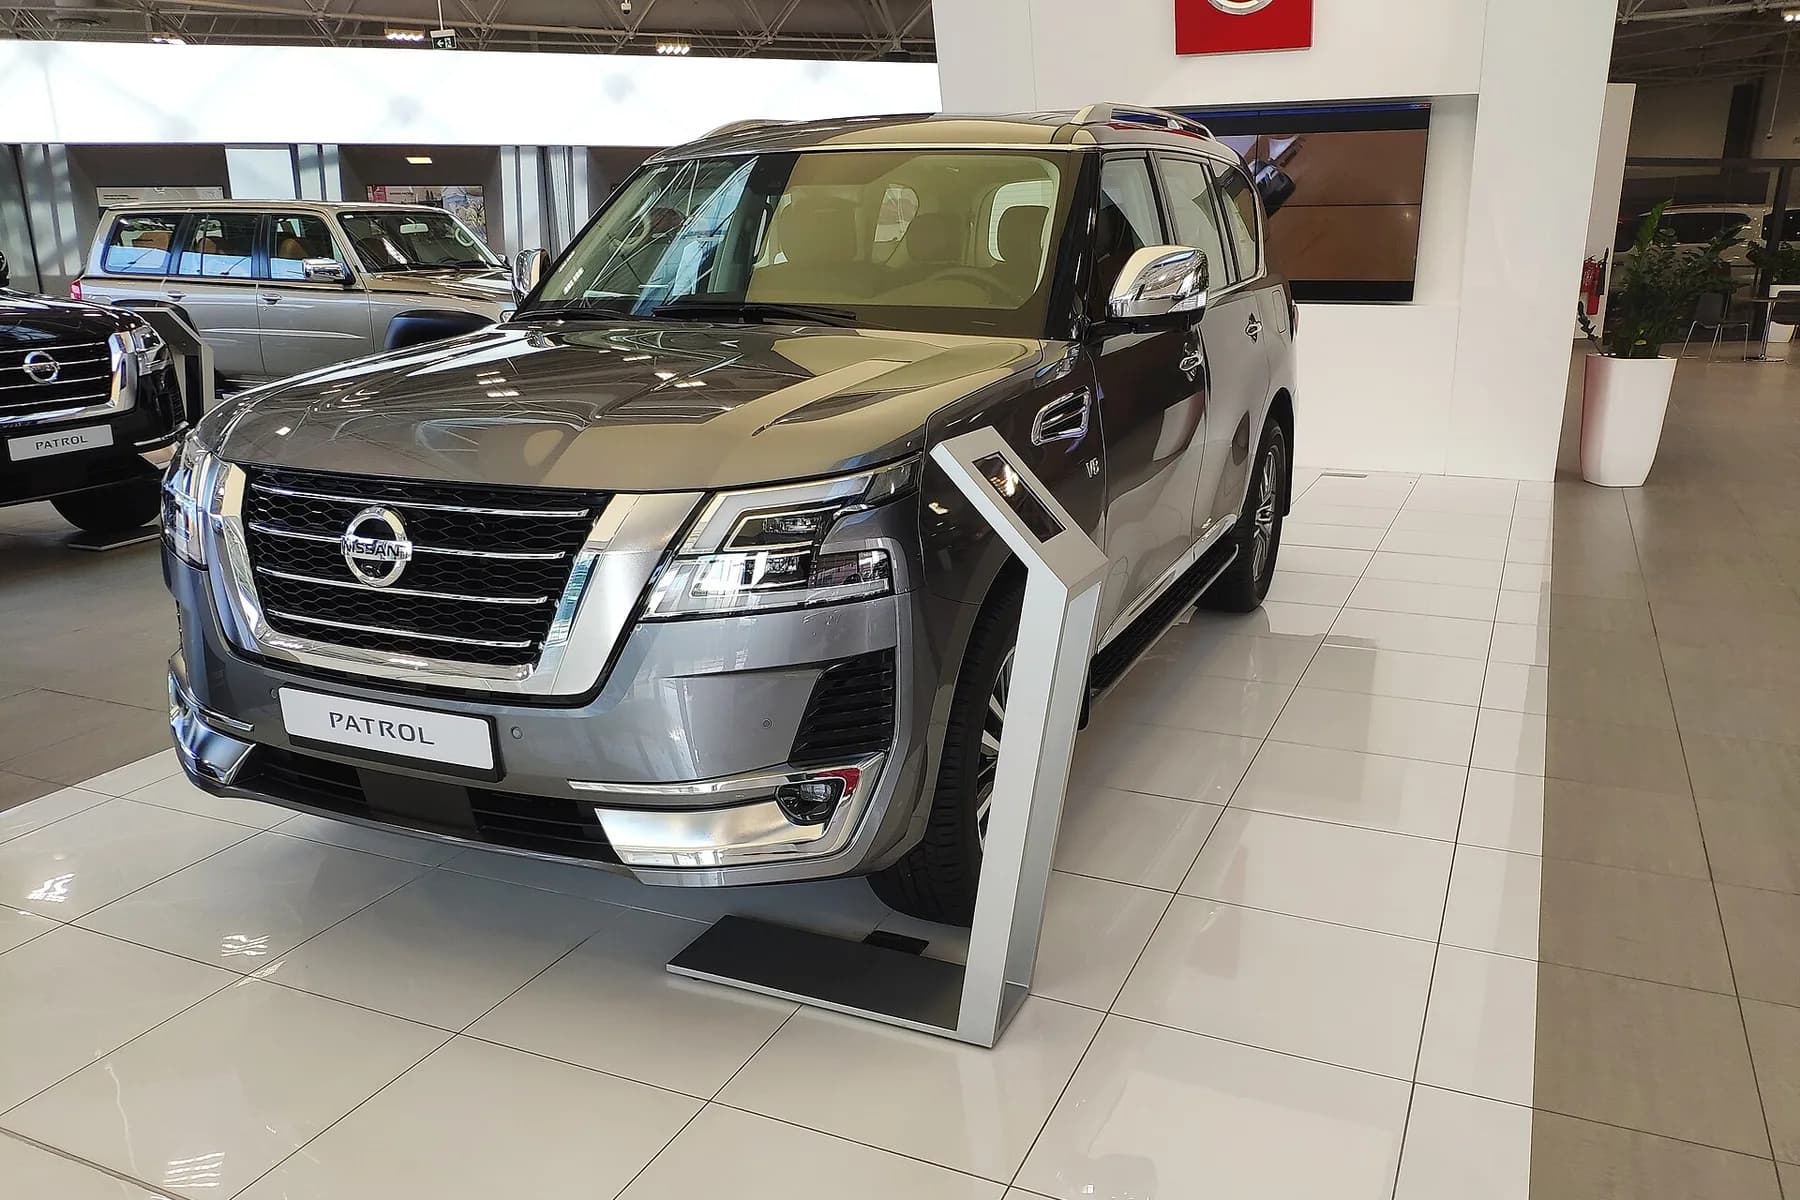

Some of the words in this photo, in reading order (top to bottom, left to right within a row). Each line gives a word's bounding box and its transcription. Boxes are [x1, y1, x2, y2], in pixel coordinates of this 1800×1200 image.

[35, 435, 88, 450] PATROL
[341, 536, 401, 557] NISSAN
[329, 711, 435, 745] PATROL
